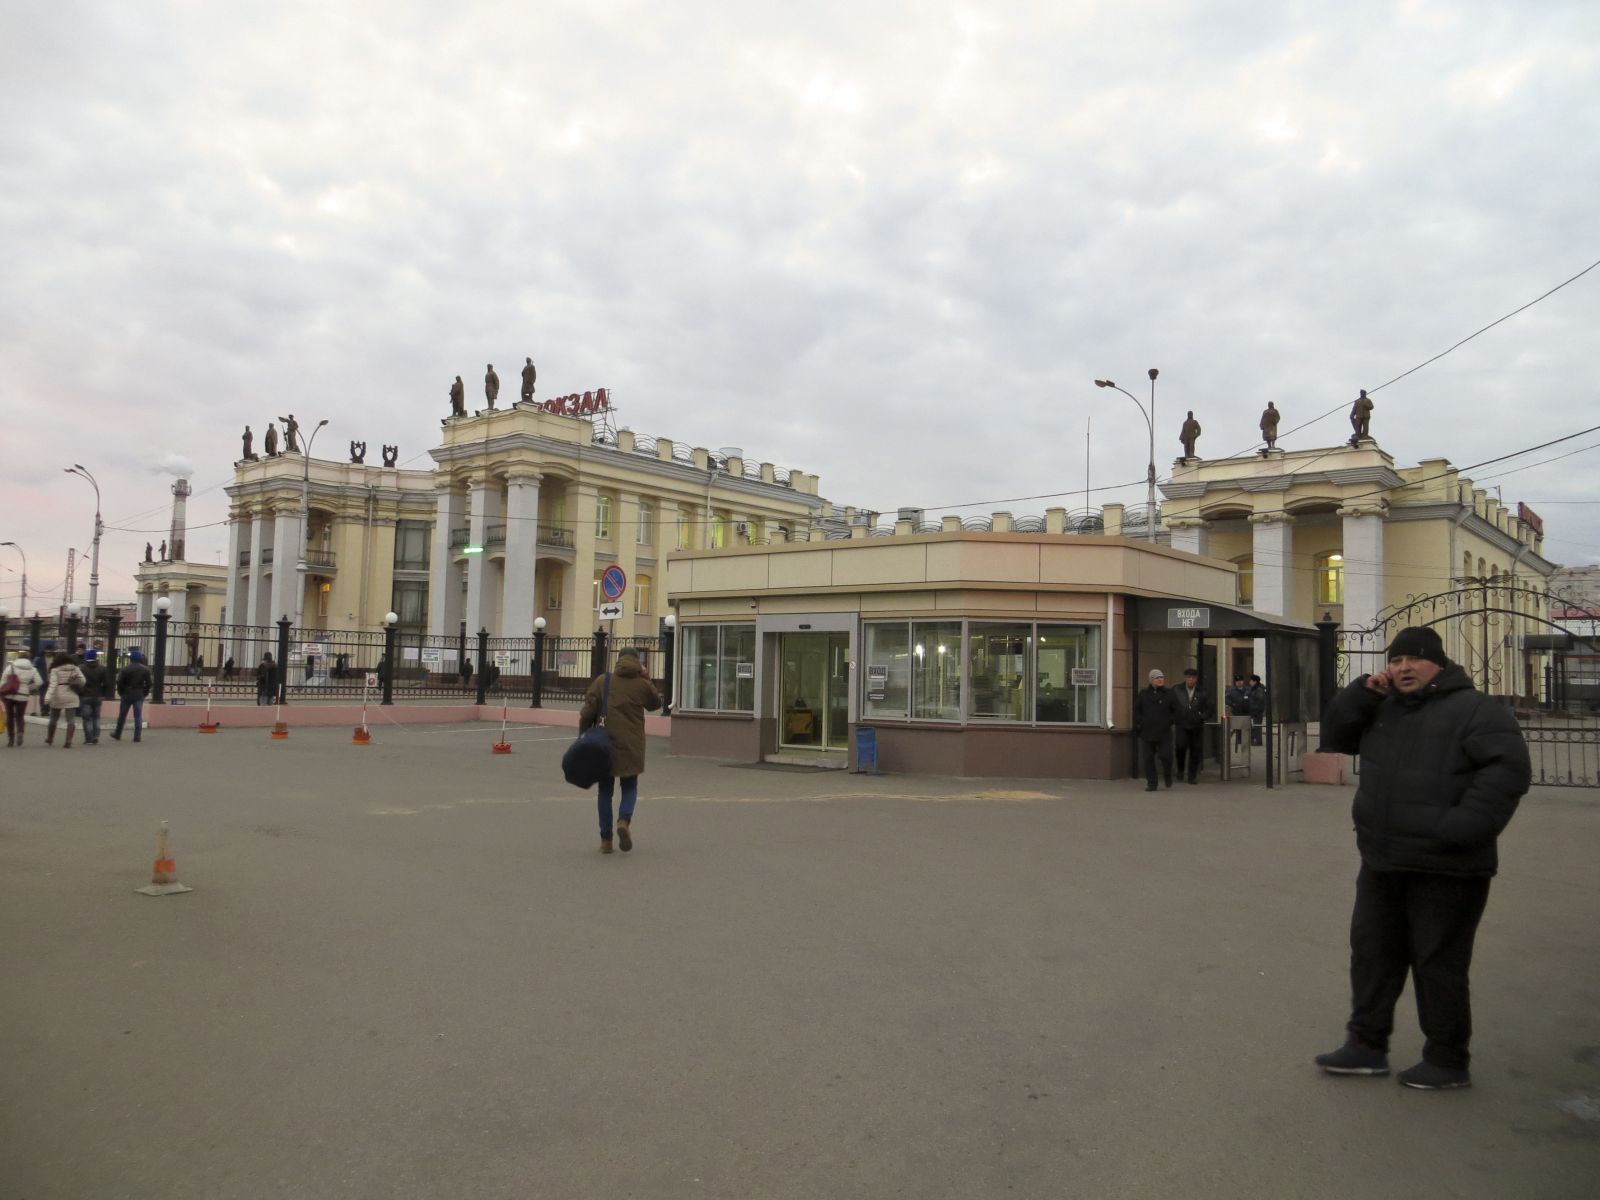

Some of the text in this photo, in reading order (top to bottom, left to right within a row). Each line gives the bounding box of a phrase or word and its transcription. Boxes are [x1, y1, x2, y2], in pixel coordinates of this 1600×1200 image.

[541, 387, 609, 415] ОКЗАЛ
[1177, 609, 1201, 618] ВХОДА
[1182, 619, 1195, 627] НЕТ
